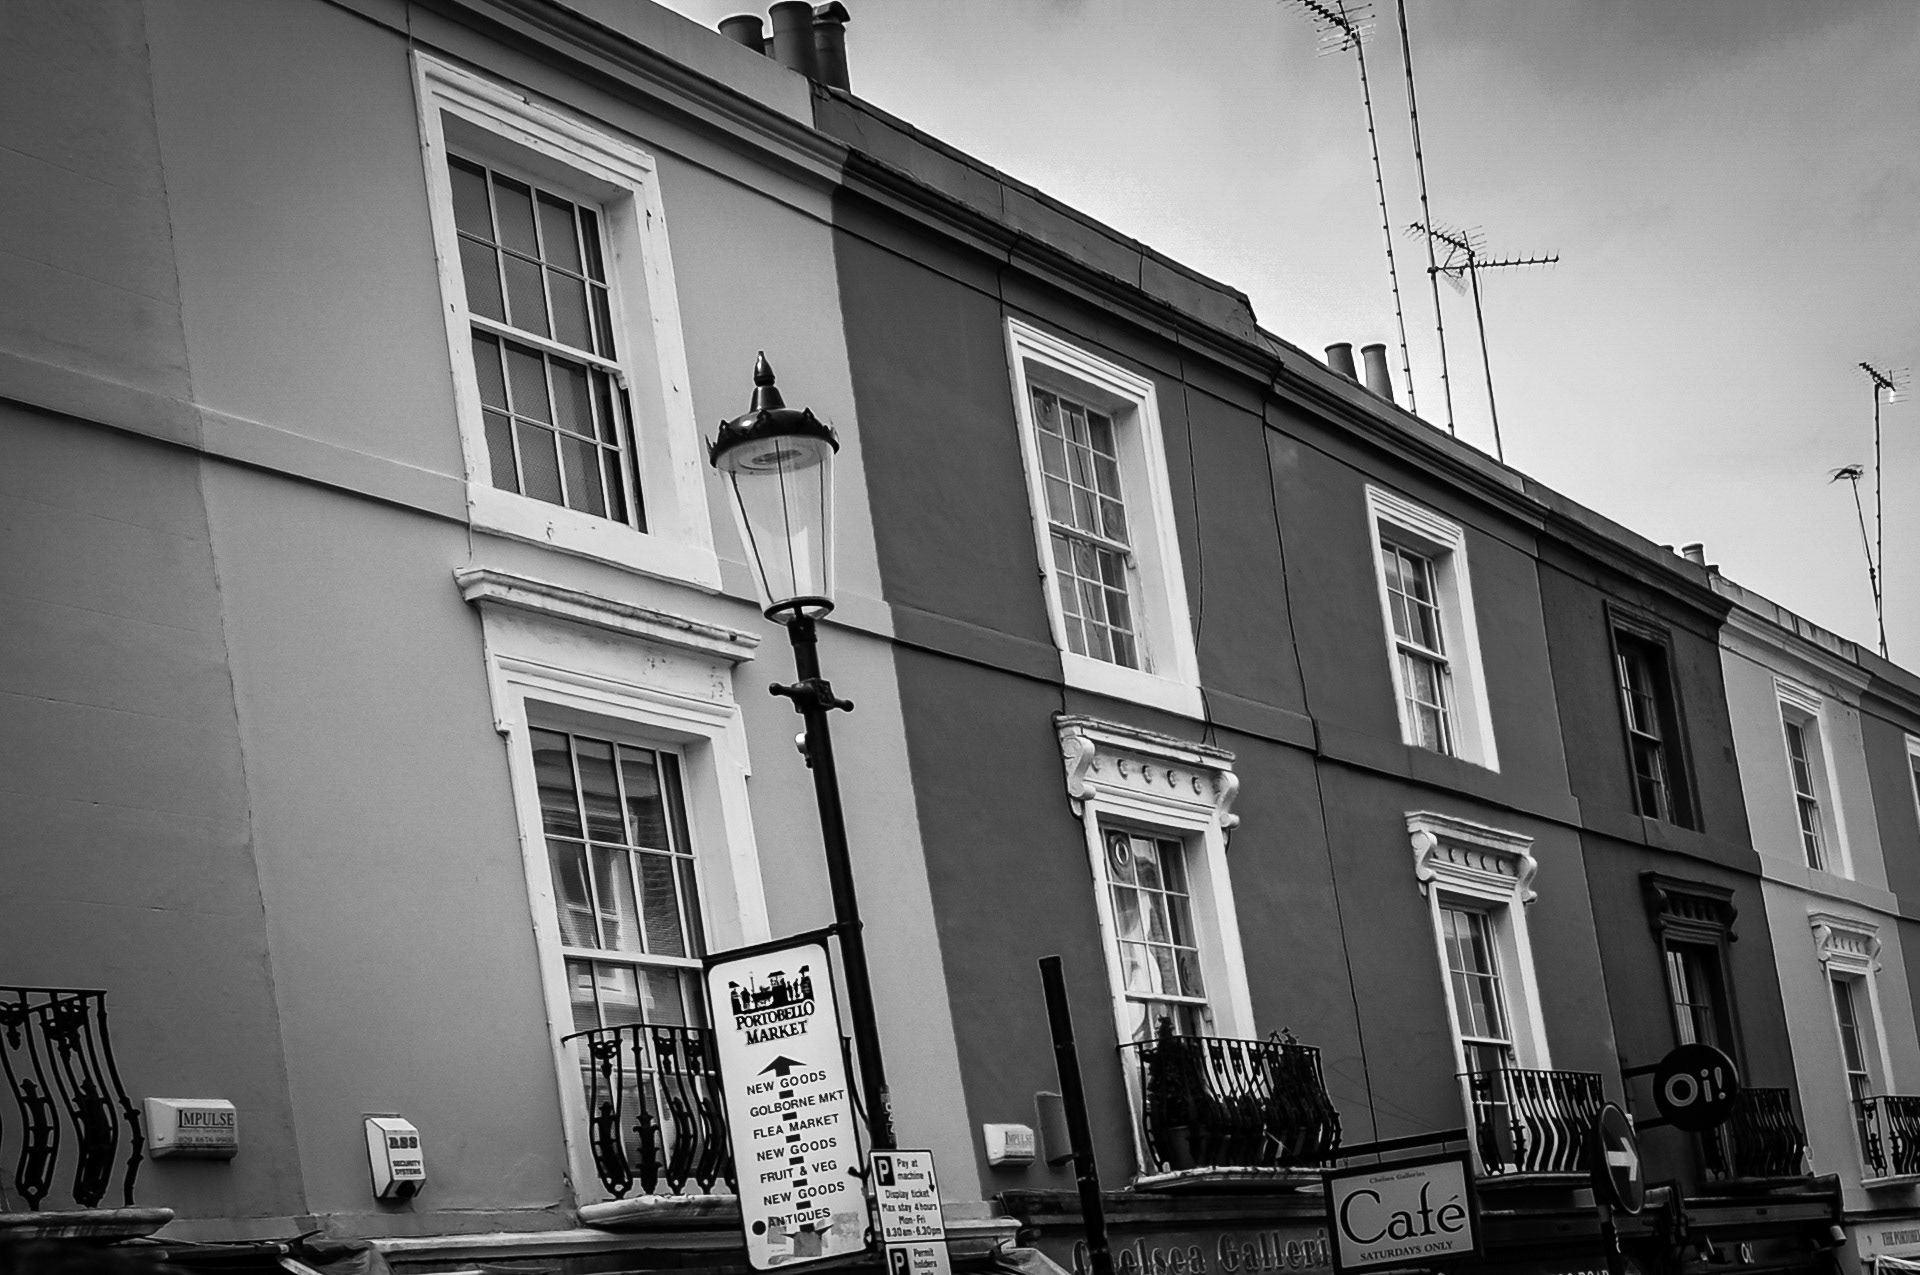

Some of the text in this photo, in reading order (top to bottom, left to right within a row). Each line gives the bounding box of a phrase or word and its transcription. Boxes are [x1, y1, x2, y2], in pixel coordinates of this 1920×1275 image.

[735, 1000, 815, 1031] PORTOBELLO
[746, 1020, 808, 1045] MARKET
[746, 1070, 827, 1095] NEW GOODS
[1664, 1066, 1726, 1107] Oi!
[750, 1089, 845, 1117] GOLBORNE MKT
[178, 1109, 235, 1128] IMPULSE
[753, 1113, 839, 1139] FLEA MARKET
[757, 1137, 837, 1161] NEW GOODS
[760, 1160, 837, 1183] FRUIT & VEG
[878, 1159, 889, 1183] P
[897, 1158, 909, 1169] Pay
[897, 1171, 924, 1180] machine
[763, 1181, 845, 1206] NEW GOODS
[885, 1189, 909, 1200] Display
[768, 1207, 831, 1228] ANTIQUES
[1340, 1181, 1466, 1245] Café
[1072, 1237, 1207, 1275] Celsea
[1360, 1241, 1454, 1261] SATURDAYS ONLY
